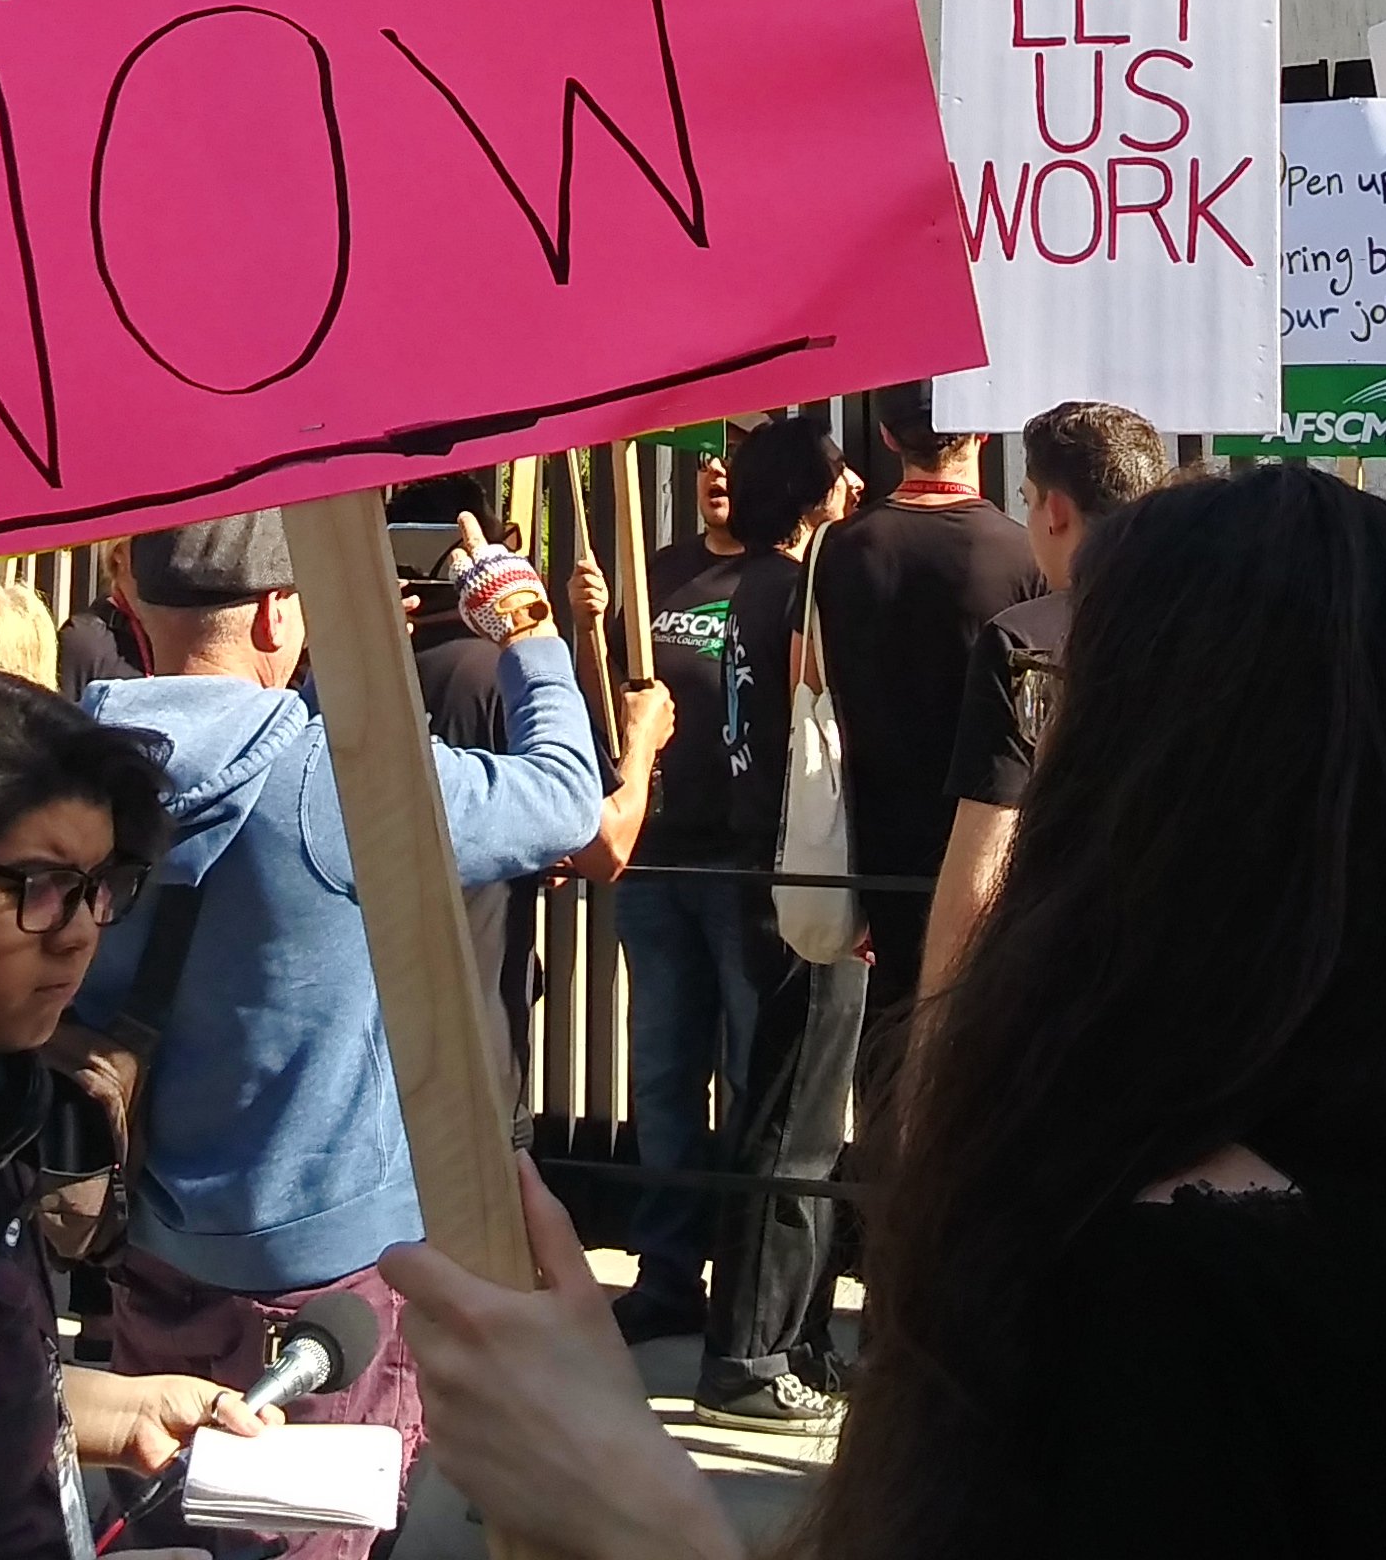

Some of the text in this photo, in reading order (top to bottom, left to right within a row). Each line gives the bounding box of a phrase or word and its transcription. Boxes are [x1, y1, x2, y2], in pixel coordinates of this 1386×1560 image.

[1034, 48, 1195, 154] US
[949, 155, 1255, 268] WORK
[1281, 246, 1355, 296] ring
[650, 610, 727, 639] AFSCM
[676, 634, 708, 647] Council
